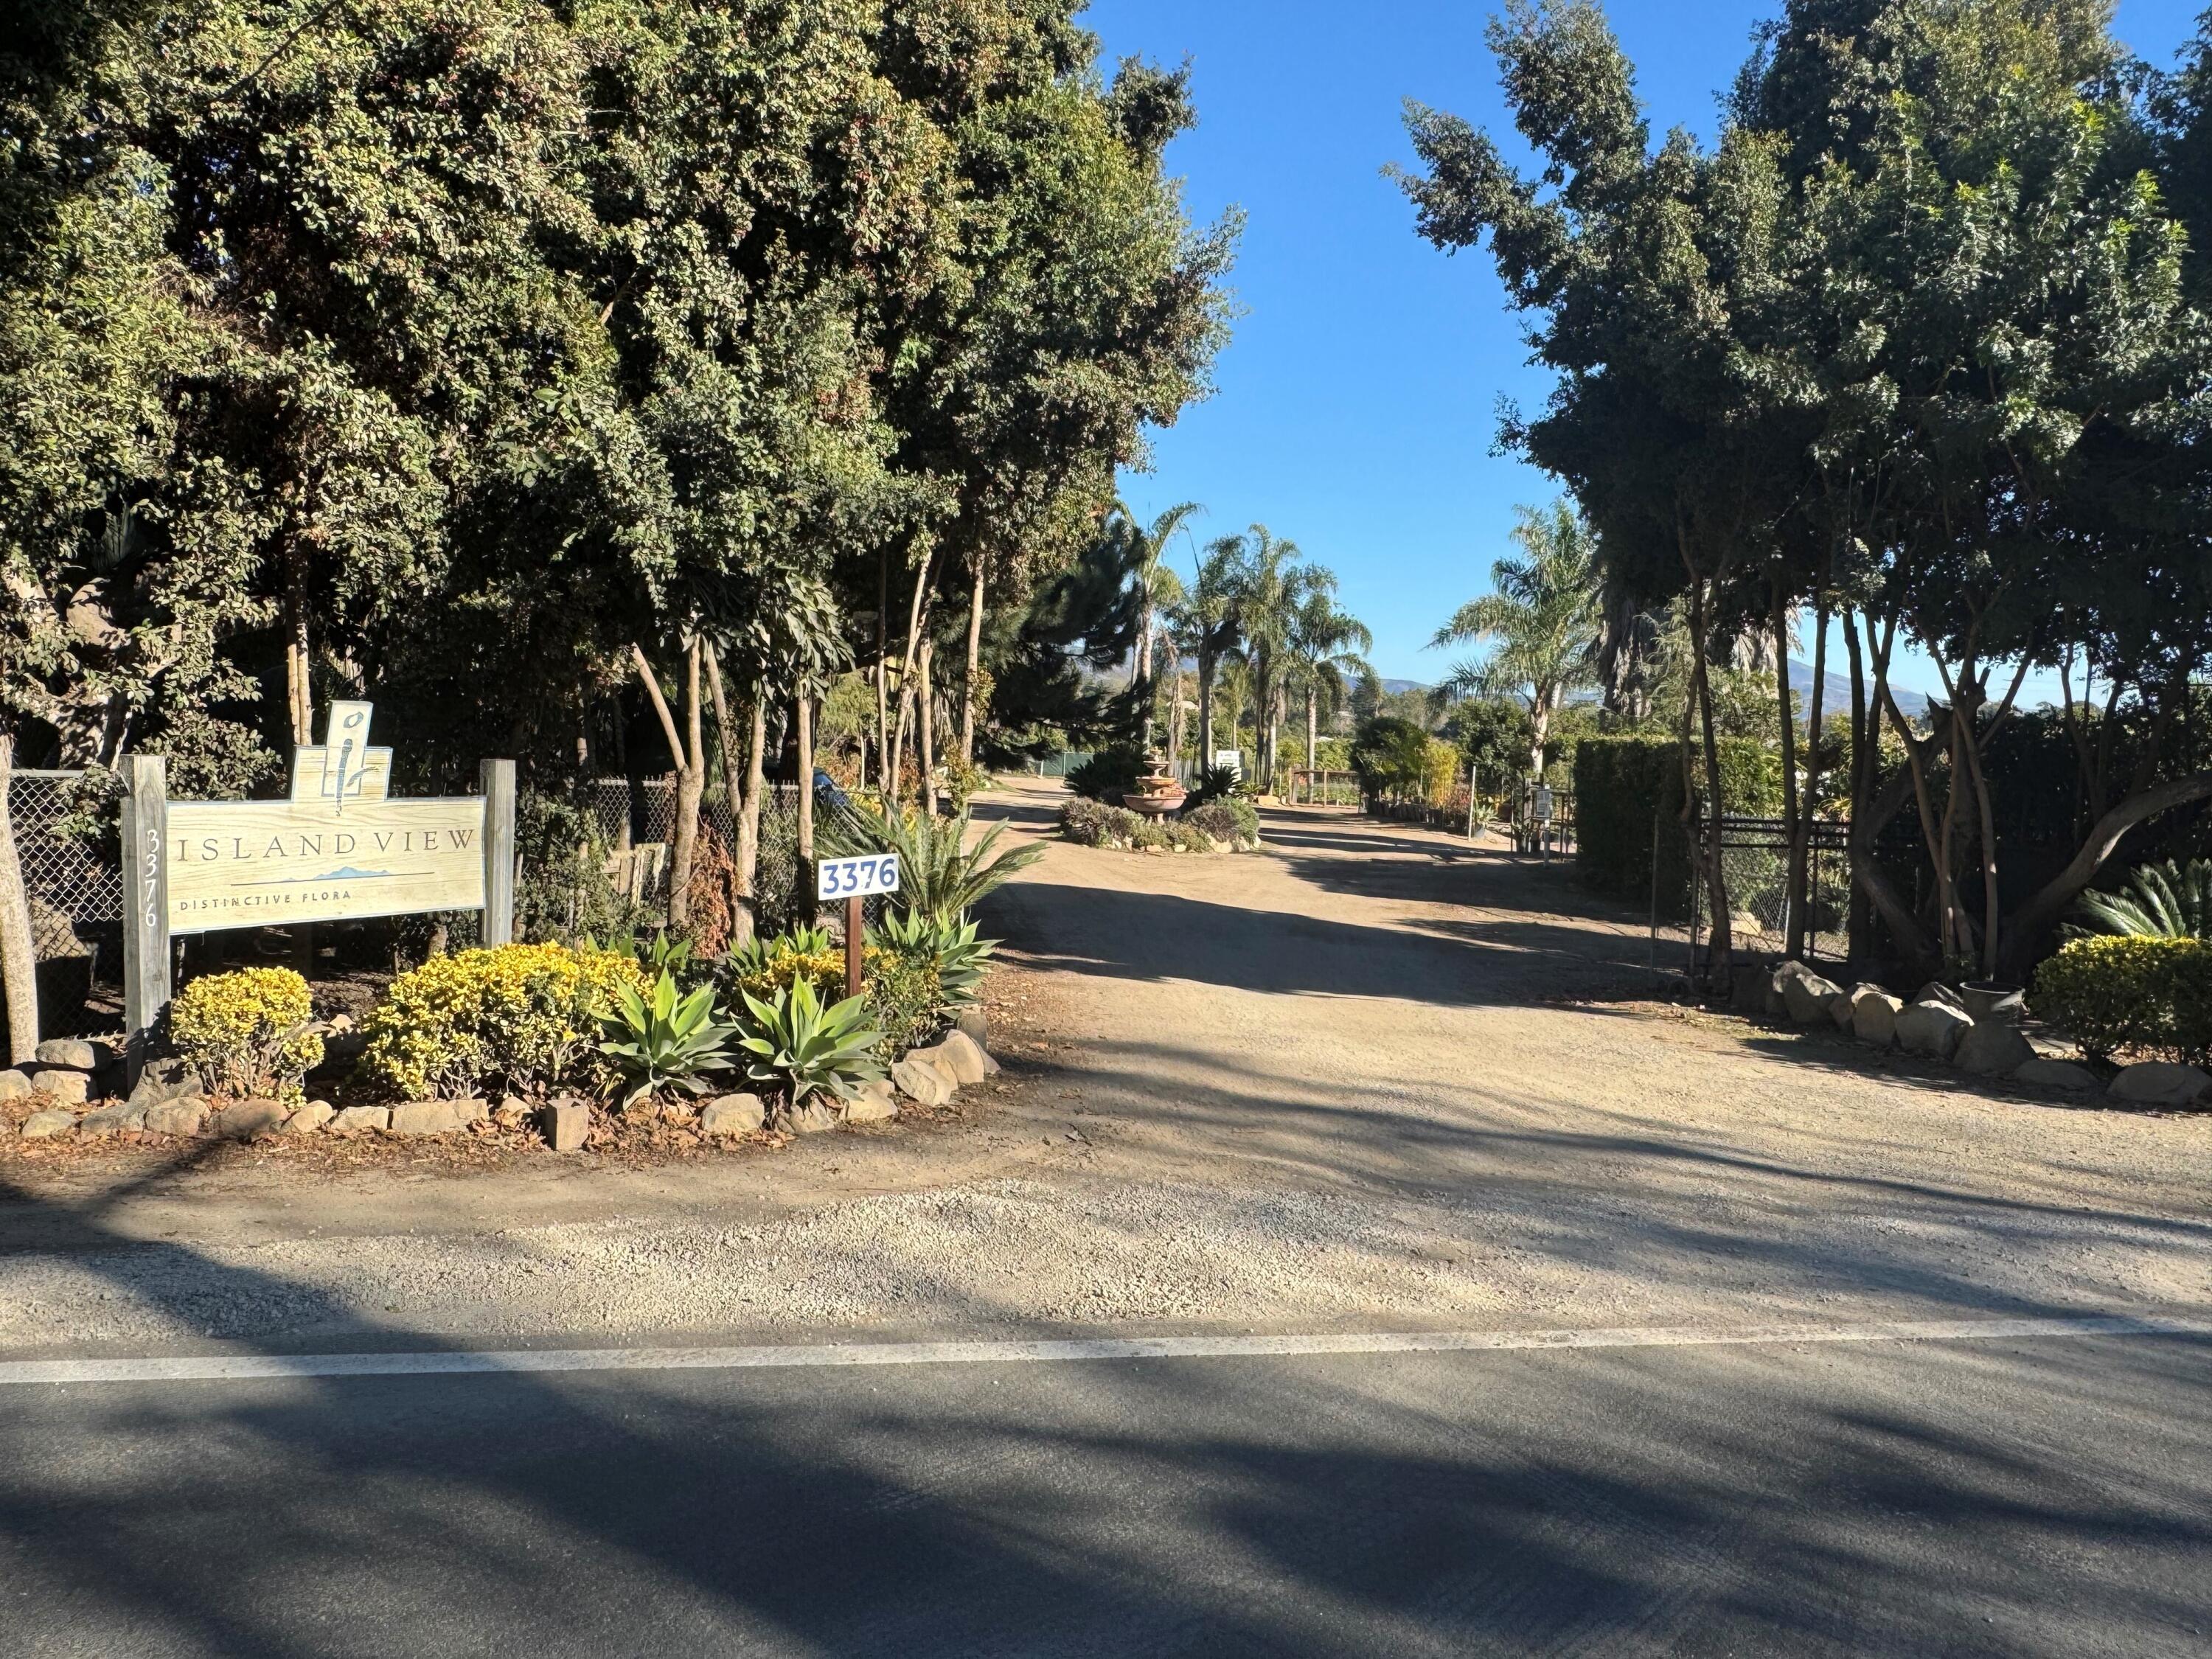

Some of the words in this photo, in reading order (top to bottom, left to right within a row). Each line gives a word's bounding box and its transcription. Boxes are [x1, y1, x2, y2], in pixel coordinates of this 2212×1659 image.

[177, 833, 356, 862] ISLAND
[374, 828, 475, 852] VIEW
[145, 829, 160, 927] 3376
[823, 858, 896, 894] 3376
[180, 894, 291, 911] DISTINCTIVE
[302, 890, 352, 903] FLORA
